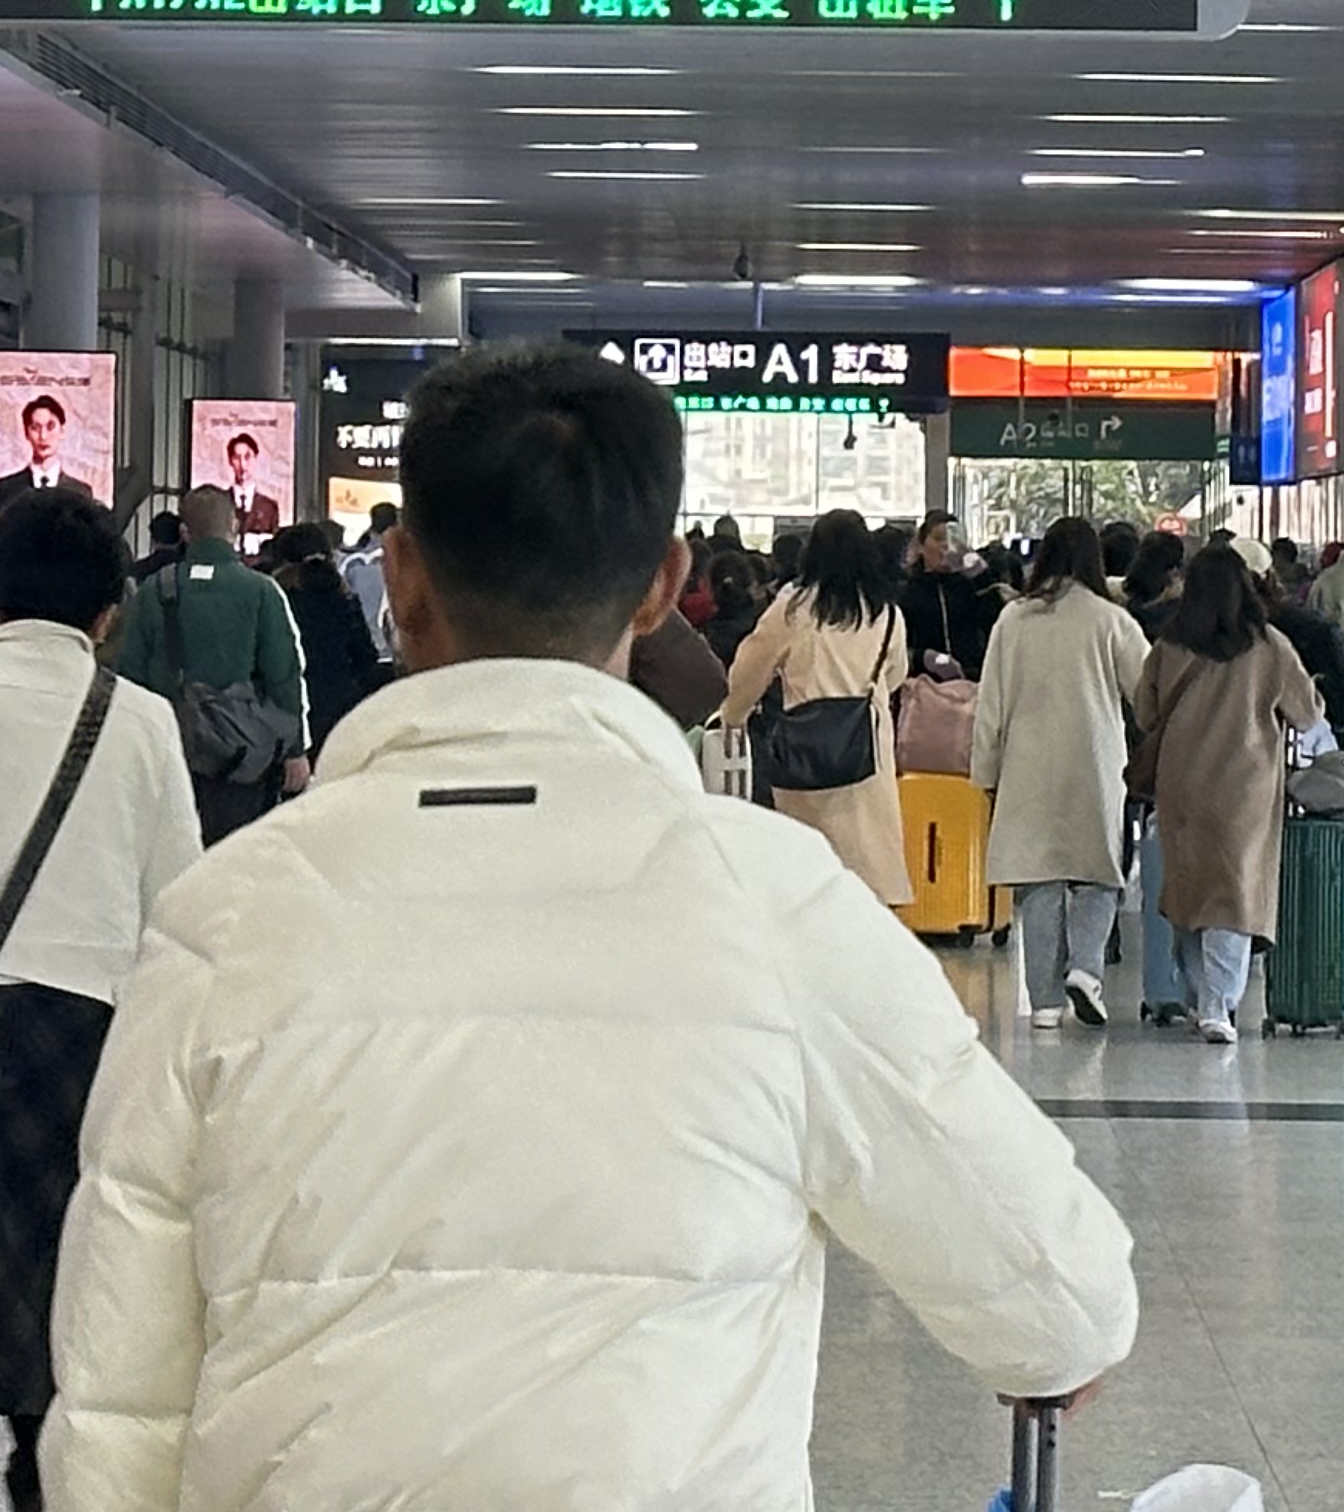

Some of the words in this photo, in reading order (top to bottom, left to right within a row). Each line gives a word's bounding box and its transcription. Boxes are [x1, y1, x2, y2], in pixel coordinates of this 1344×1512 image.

[762, 343, 819, 384] A1
[832, 343, 908, 370] 东广场
